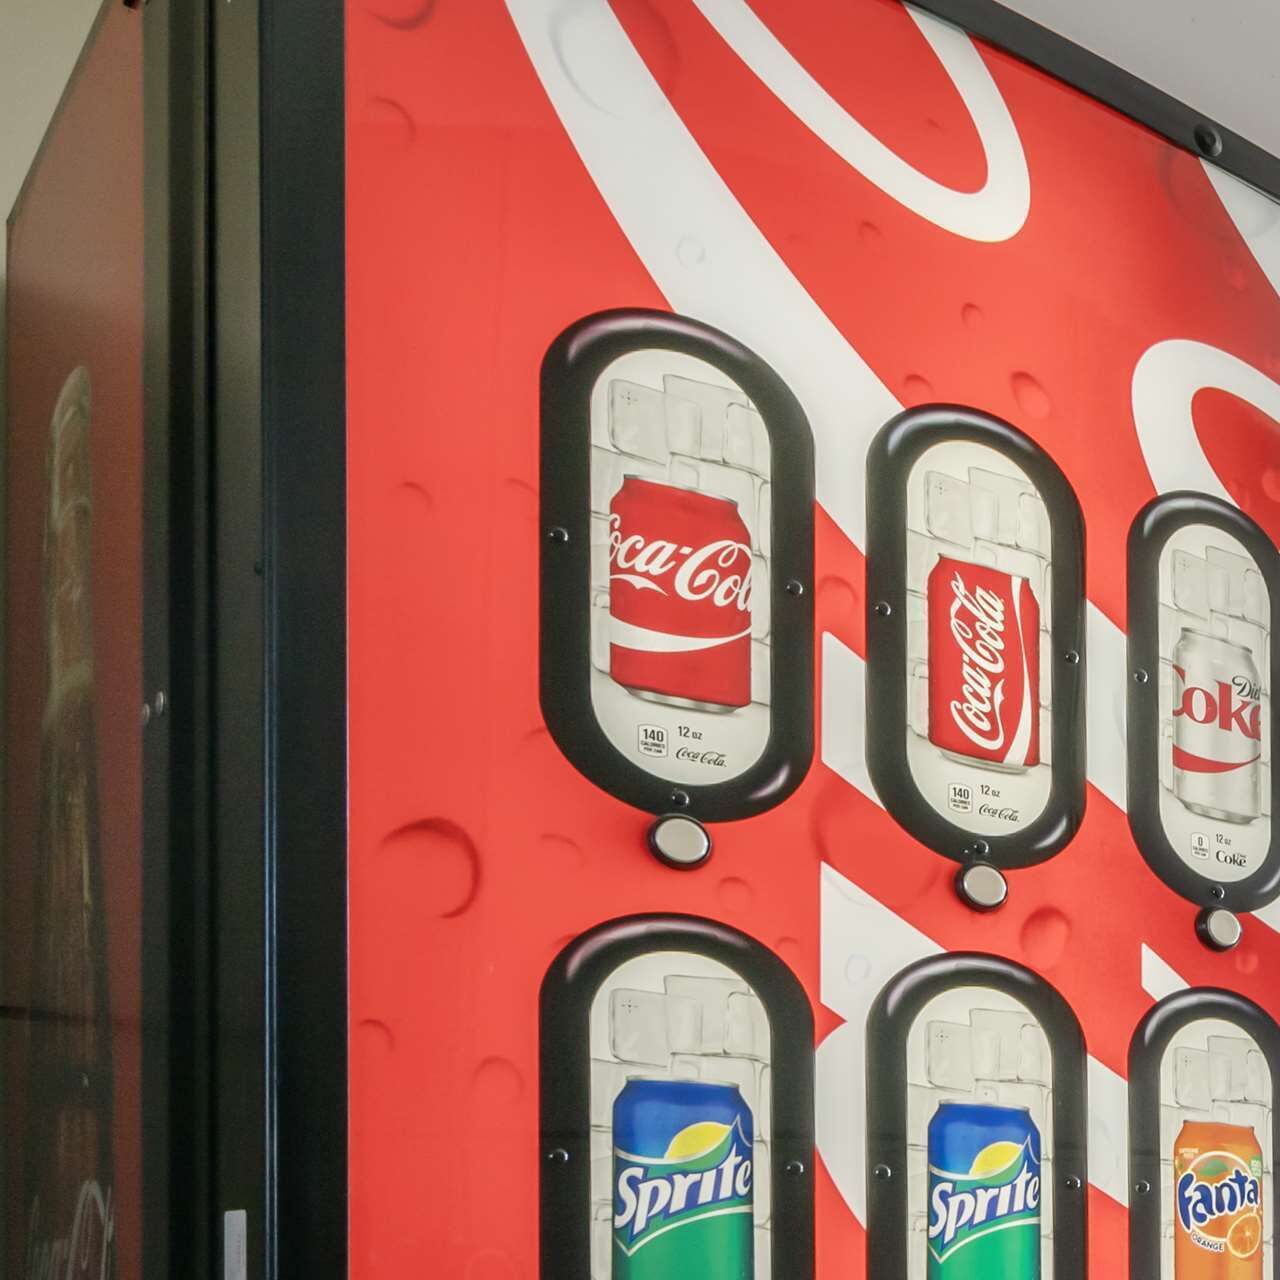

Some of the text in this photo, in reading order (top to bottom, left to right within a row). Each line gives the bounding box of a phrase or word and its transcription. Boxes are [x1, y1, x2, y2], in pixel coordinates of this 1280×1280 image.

[950, 571, 1005, 750] Coca-Cola
[643, 728, 664, 742] 140
[678, 726, 690, 738] 12
[953, 787, 969, 799] 140
[980, 784, 990, 795] 12
[1216, 833, 1223, 844] 12
[614, 1142, 751, 1235] Sprite
[929, 1160, 1039, 1244] Sprite
[1178, 1168, 1260, 1232] Fanta
[1192, 1231, 1225, 1252] ORANGE
